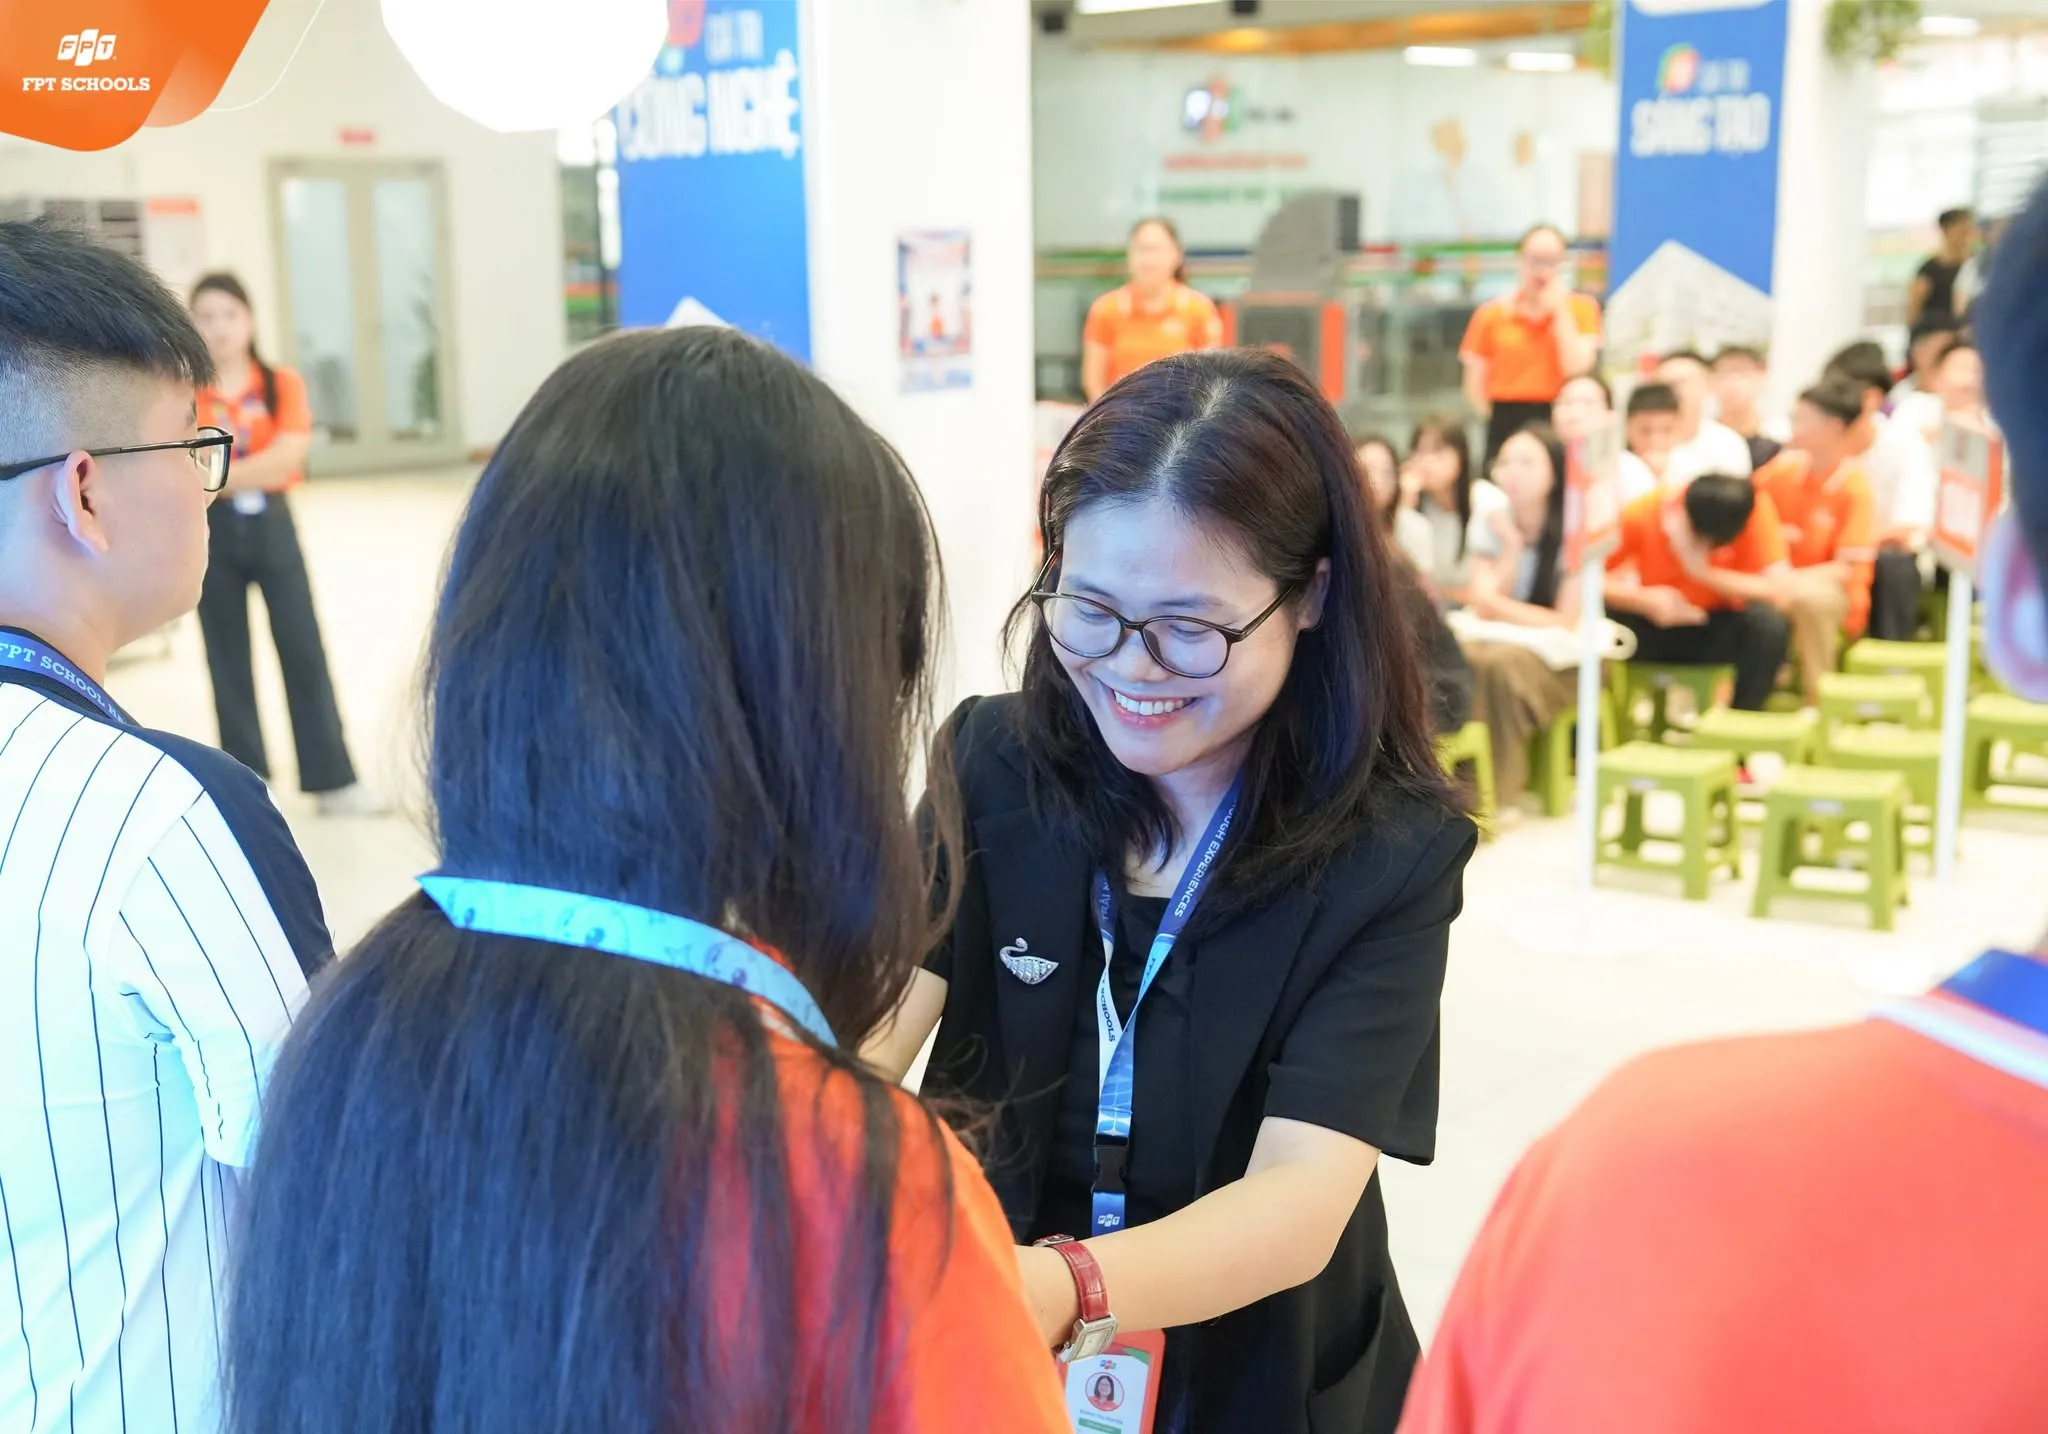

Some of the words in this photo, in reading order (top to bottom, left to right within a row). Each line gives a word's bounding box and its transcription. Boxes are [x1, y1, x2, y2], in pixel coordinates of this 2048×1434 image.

[0, 643, 36, 663] FPT
[40, 655, 106, 708] SCHOOL
[1174, 840, 1220, 917] EXPERIENCES
